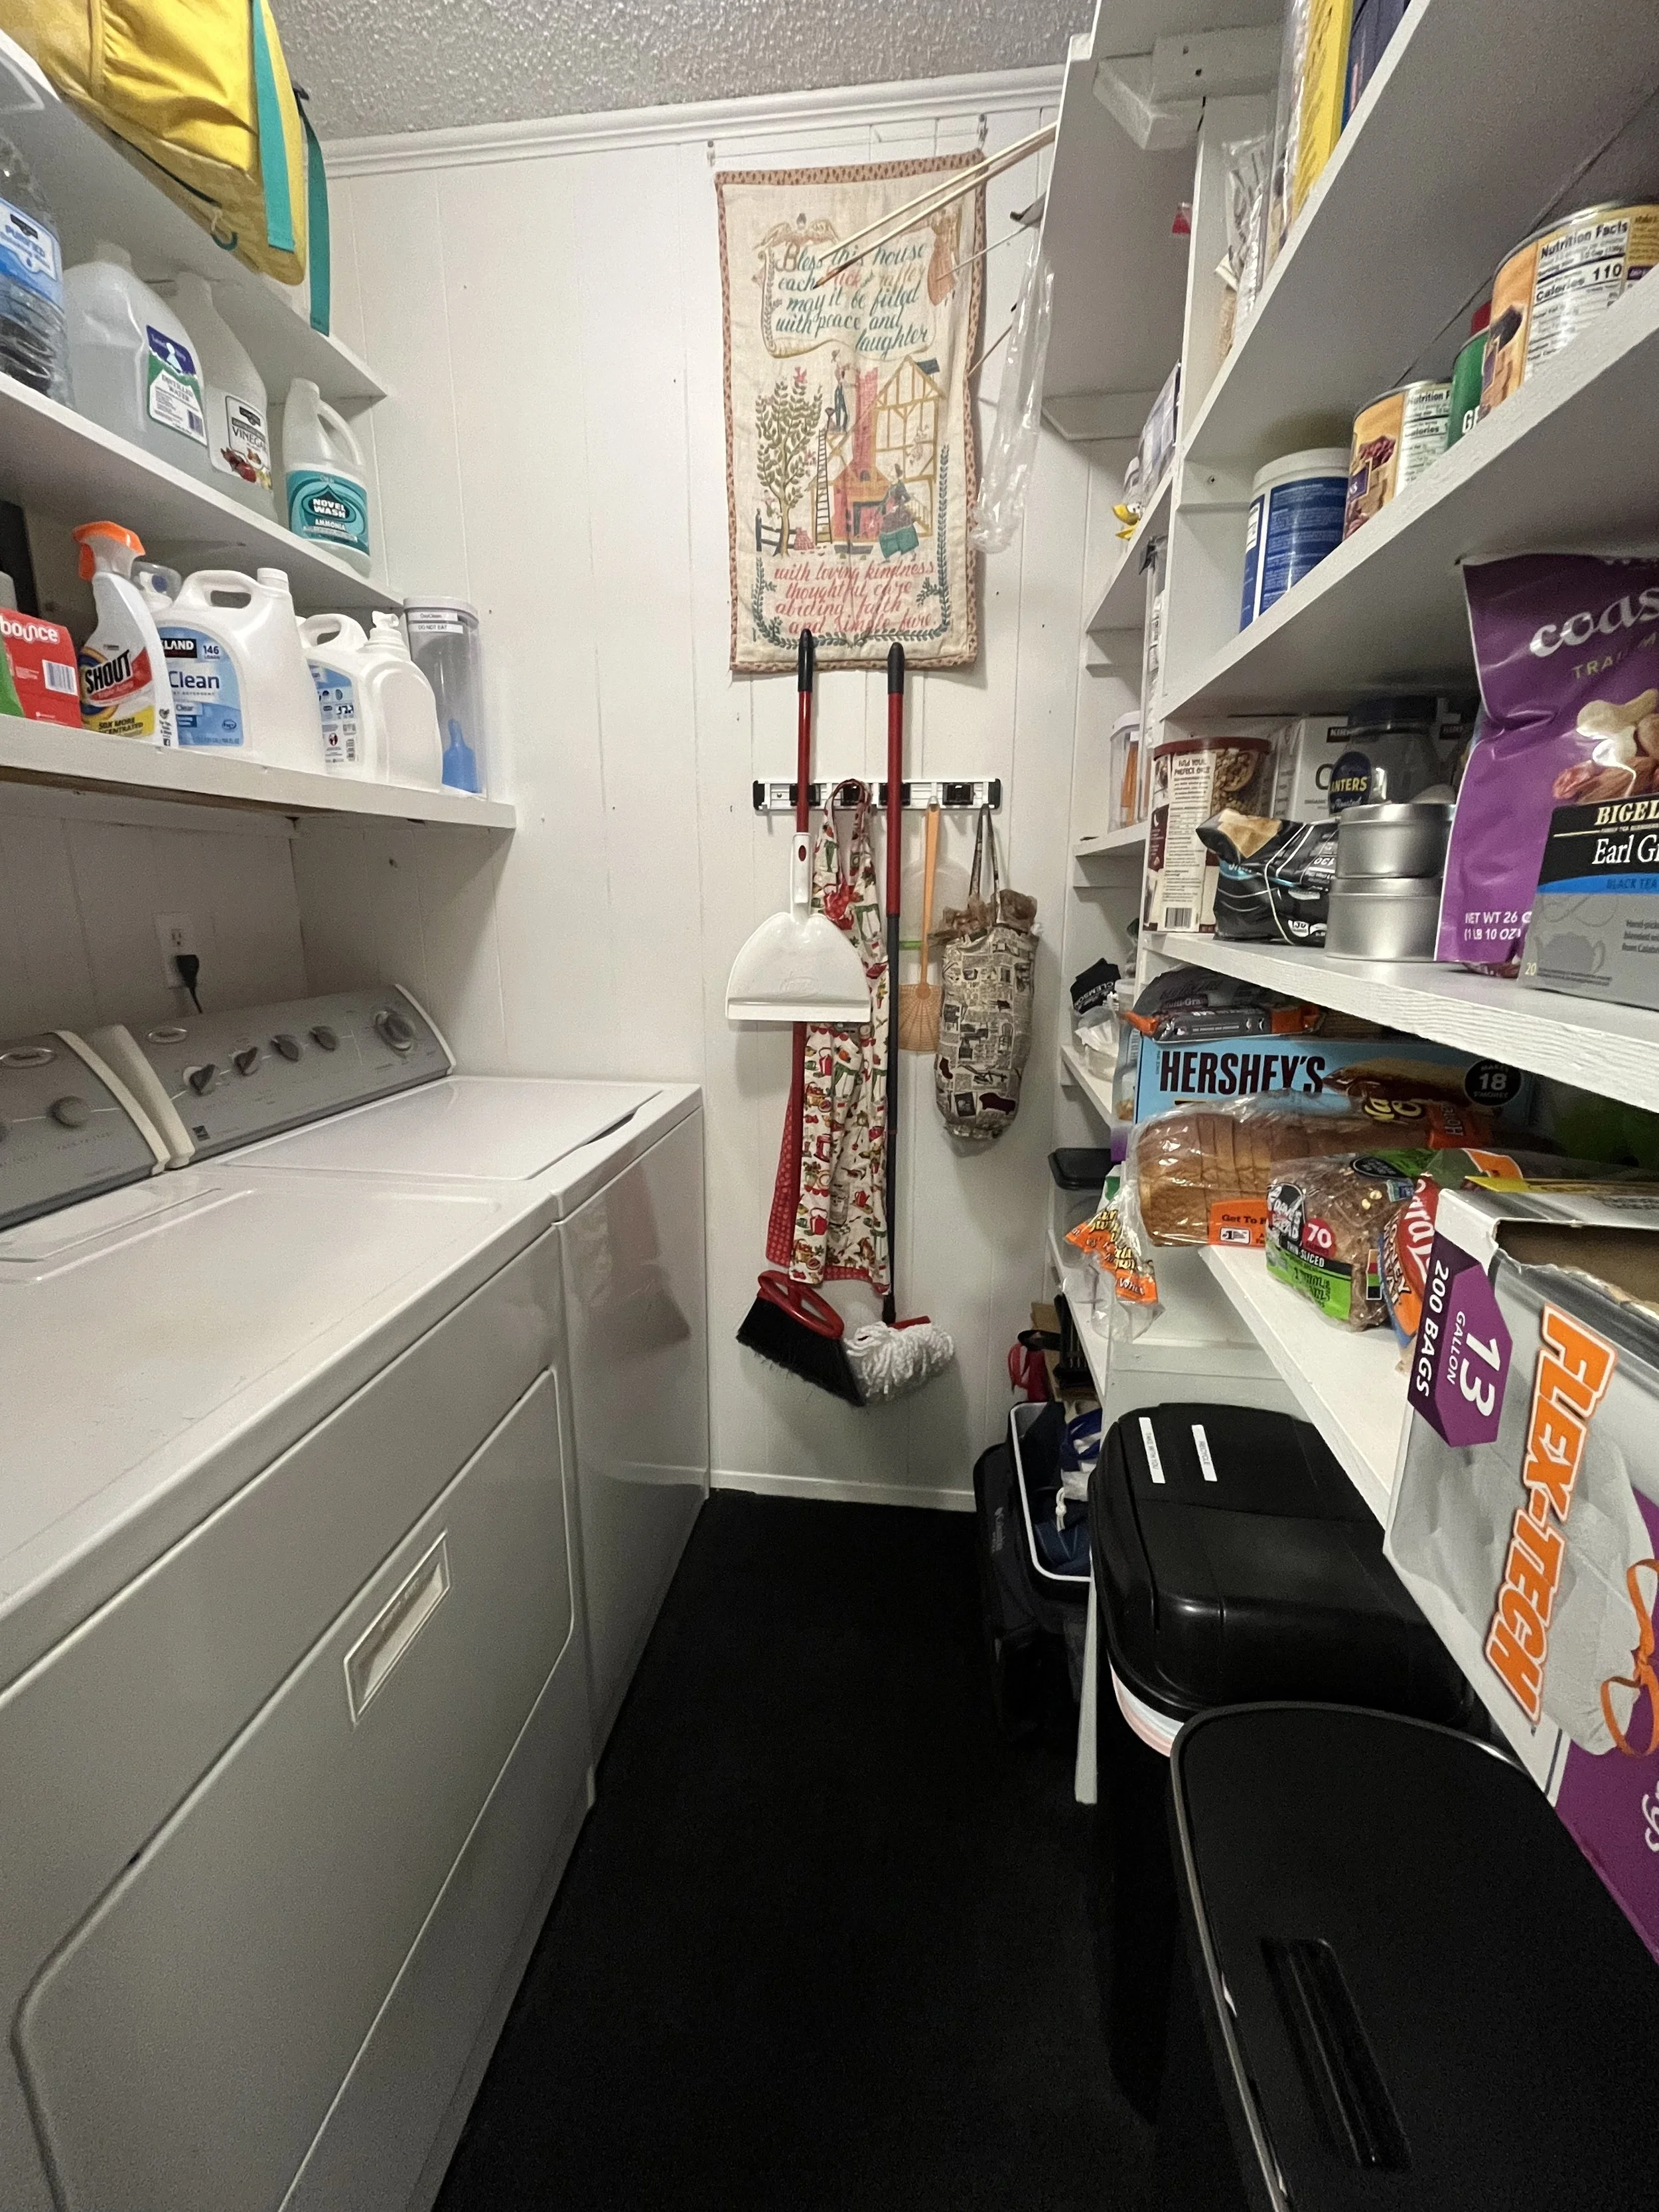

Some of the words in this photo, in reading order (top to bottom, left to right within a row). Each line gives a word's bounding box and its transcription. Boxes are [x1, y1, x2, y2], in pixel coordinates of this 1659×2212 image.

[1541, 230, 1591, 259] Nutrition
[1595, 220, 1628, 238] Facts
[873, 244, 925, 267] house
[1536, 277, 1585, 302] Calories
[1593, 263, 1623, 281] 110
[786, 293, 826, 322] may
[829, 287, 843, 307] it
[851, 288, 865, 309] be
[775, 313, 812, 335] with
[815, 314, 861, 338] peace
[869, 309, 902, 331] and
[855, 325, 928, 360] laughter
[313, 498, 346, 512] NOVEL
[313, 505, 346, 519] WASH
[315, 518, 346, 531] AMMONIA
[774, 561, 811, 581] with
[816, 561, 859, 582] loving
[0, 615, 58, 642] bounce
[202, 645, 220, 655] 146
[85, 649, 131, 694] SHOUT
[169, 670, 220, 689] Clean
[1592, 834, 1634, 864] Earl
[1607, 877, 1636, 890] BLACK
[1639, 877, 1658, 890] TEA
[1465, 912, 1480, 924] NET
[1483, 911, 1502, 924] WT
[1503, 911, 1518, 923] 26
[1473, 928, 1482, 940] LB
[1485, 928, 1497, 940] 10
[1525, 962, 1537, 976] 20
[1160, 1051, 1325, 1095] HERSHEY'S
[1479, 1072, 1507, 1090] 18
[1222, 1214, 1241, 1222] Get
[1243, 1215, 1258, 1224] To
[1307, 1223, 1333, 1249] 70
[1429, 1259, 1449, 1314] 200
[1415, 1319, 1439, 1397] BAGS
[1446, 1310, 1467, 1385] GALLON
[1459, 1331, 1500, 1417] 13
[1486, 1301, 1617, 1724] FLEX-TECH
